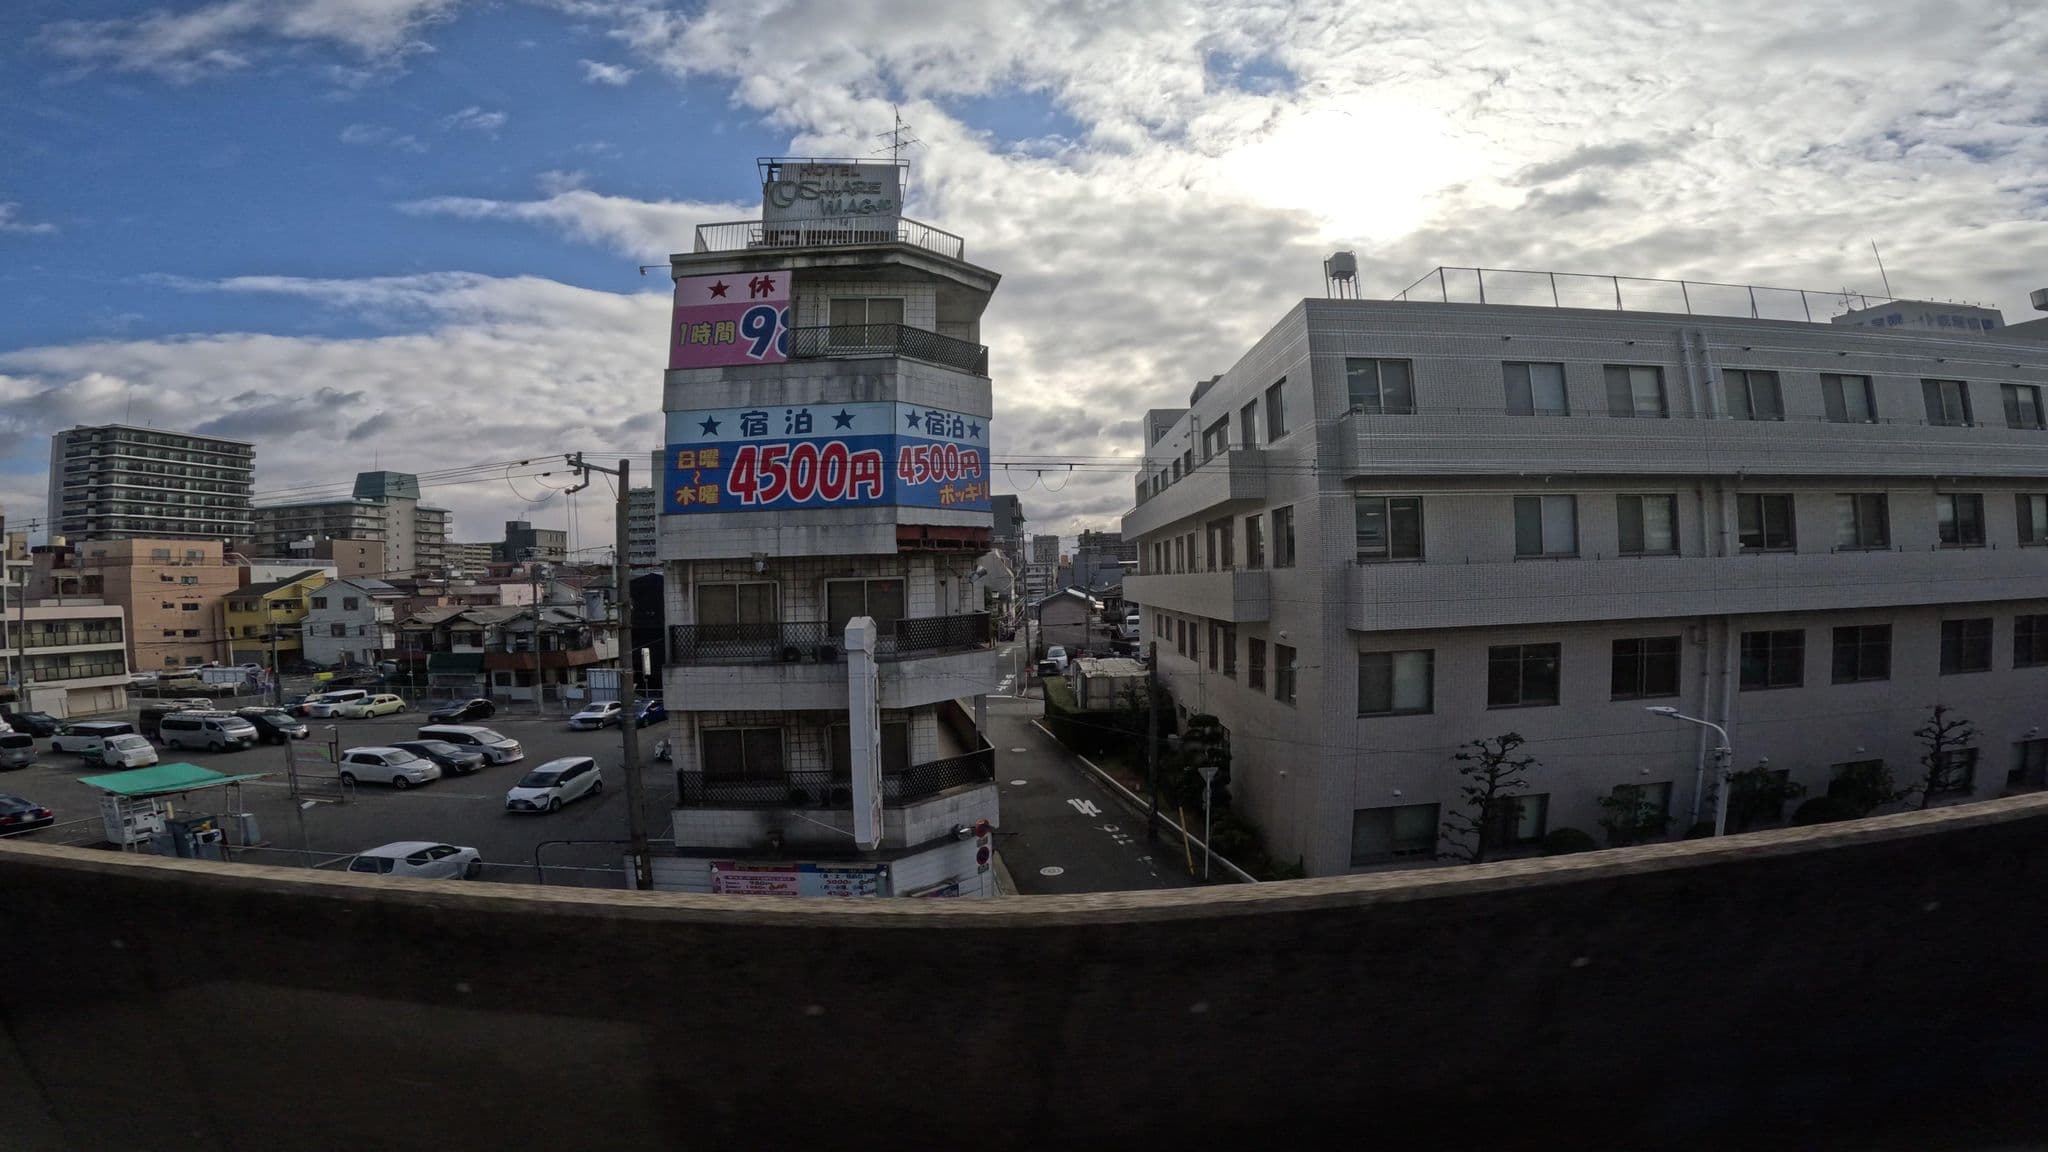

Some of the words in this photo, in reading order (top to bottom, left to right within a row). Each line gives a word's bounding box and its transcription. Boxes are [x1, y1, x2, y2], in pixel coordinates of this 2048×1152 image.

[800, 166, 860, 177] HOTEL
[748, 275, 776, 299] 休
[679, 319, 736, 346] 1時間
[739, 408, 814, 438] 宿泊
[925, 410, 965, 439] 宿泊
[677, 448, 721, 470] 日曜
[897, 443, 982, 486] 4500円
[727, 440, 884, 505] 4500円
[675, 484, 721, 507] 木曜
[938, 480, 989, 505] ポッキリ
